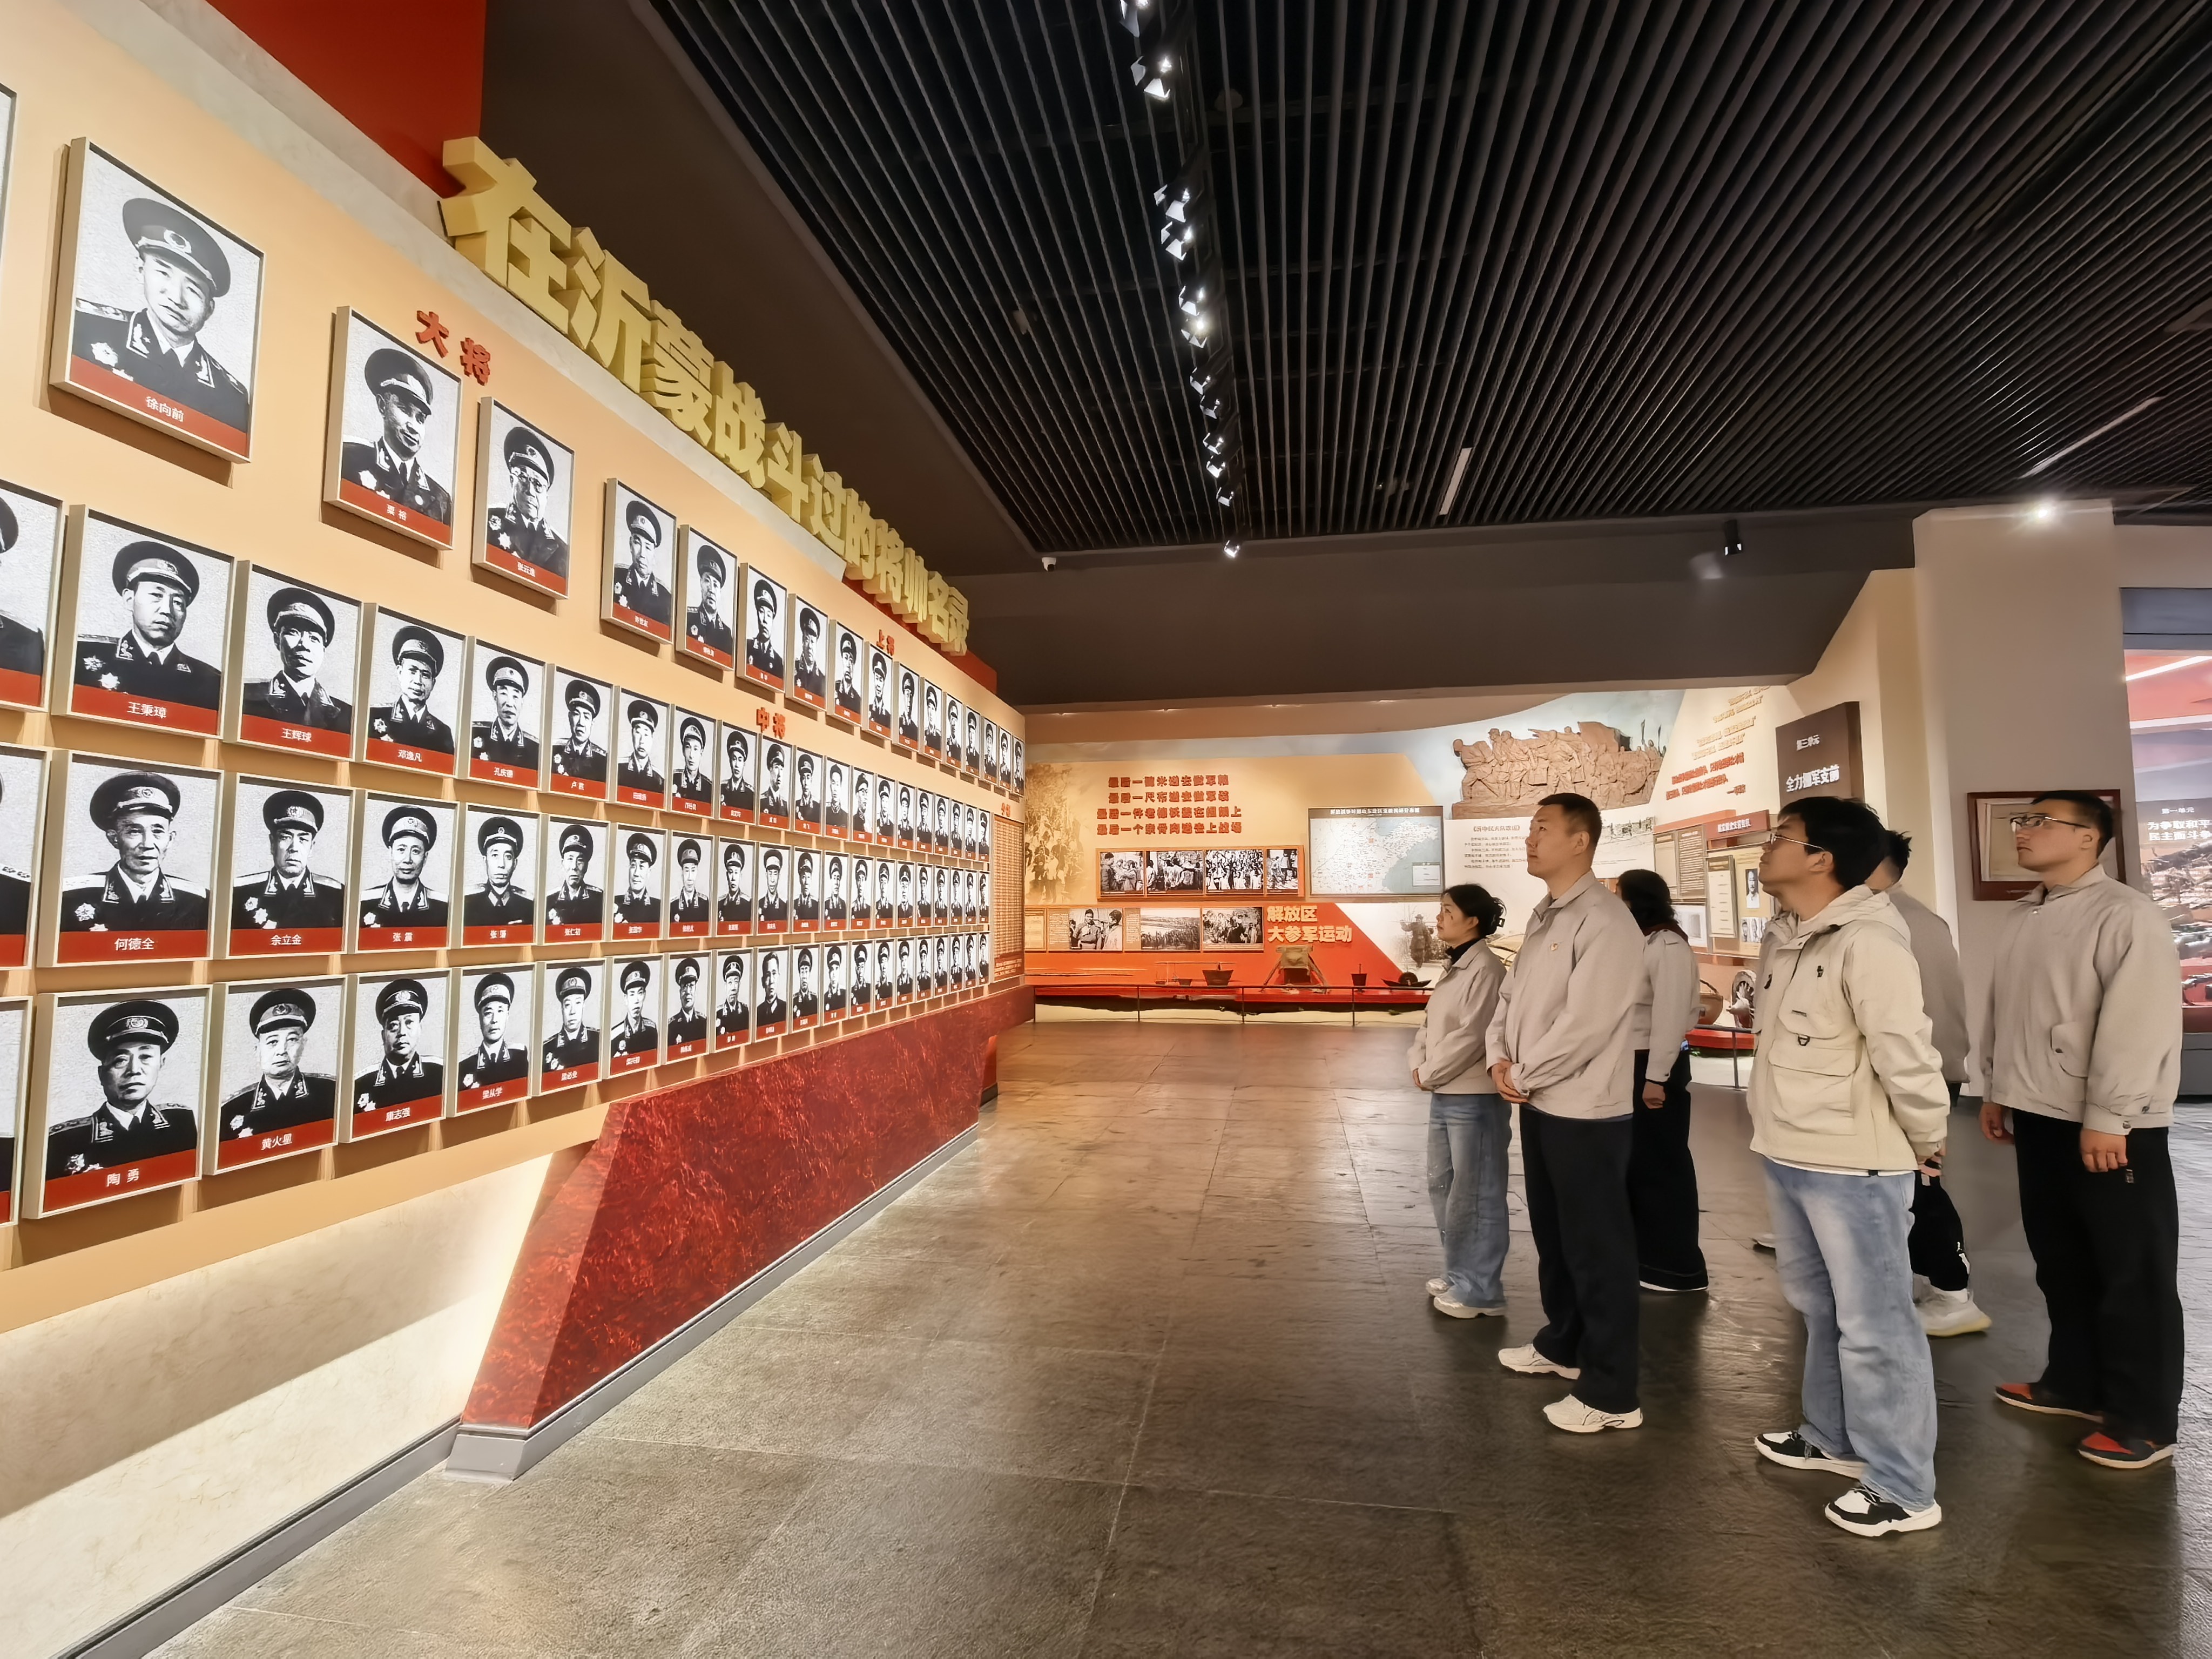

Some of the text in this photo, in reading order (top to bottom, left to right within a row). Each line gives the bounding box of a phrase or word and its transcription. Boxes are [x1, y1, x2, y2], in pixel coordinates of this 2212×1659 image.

[415, 309, 491, 386] 大将
[438, 135, 970, 658] 在沂蒙战斗过的将帅名录
[146, 396, 184, 422] 徐向前
[876, 629, 895, 657] 上将
[127, 701, 167, 719] 王秉璋
[756, 706, 786, 740] 中将
[281, 727, 312, 742] 王辉球
[397, 749, 422, 763] 邓逸凡
[1786, 764, 1840, 792] 全力拥军支前
[1267, 905, 1318, 922] 解放区
[271, 934, 302, 946] 余立金
[393, 932, 413, 942] 张震
[1267, 925, 1352, 943] 大参军运动
[114, 938, 155, 951] 何德全
[262, 1133, 293, 1150] 黄火星
[106, 1168, 139, 1187] 陶勇
